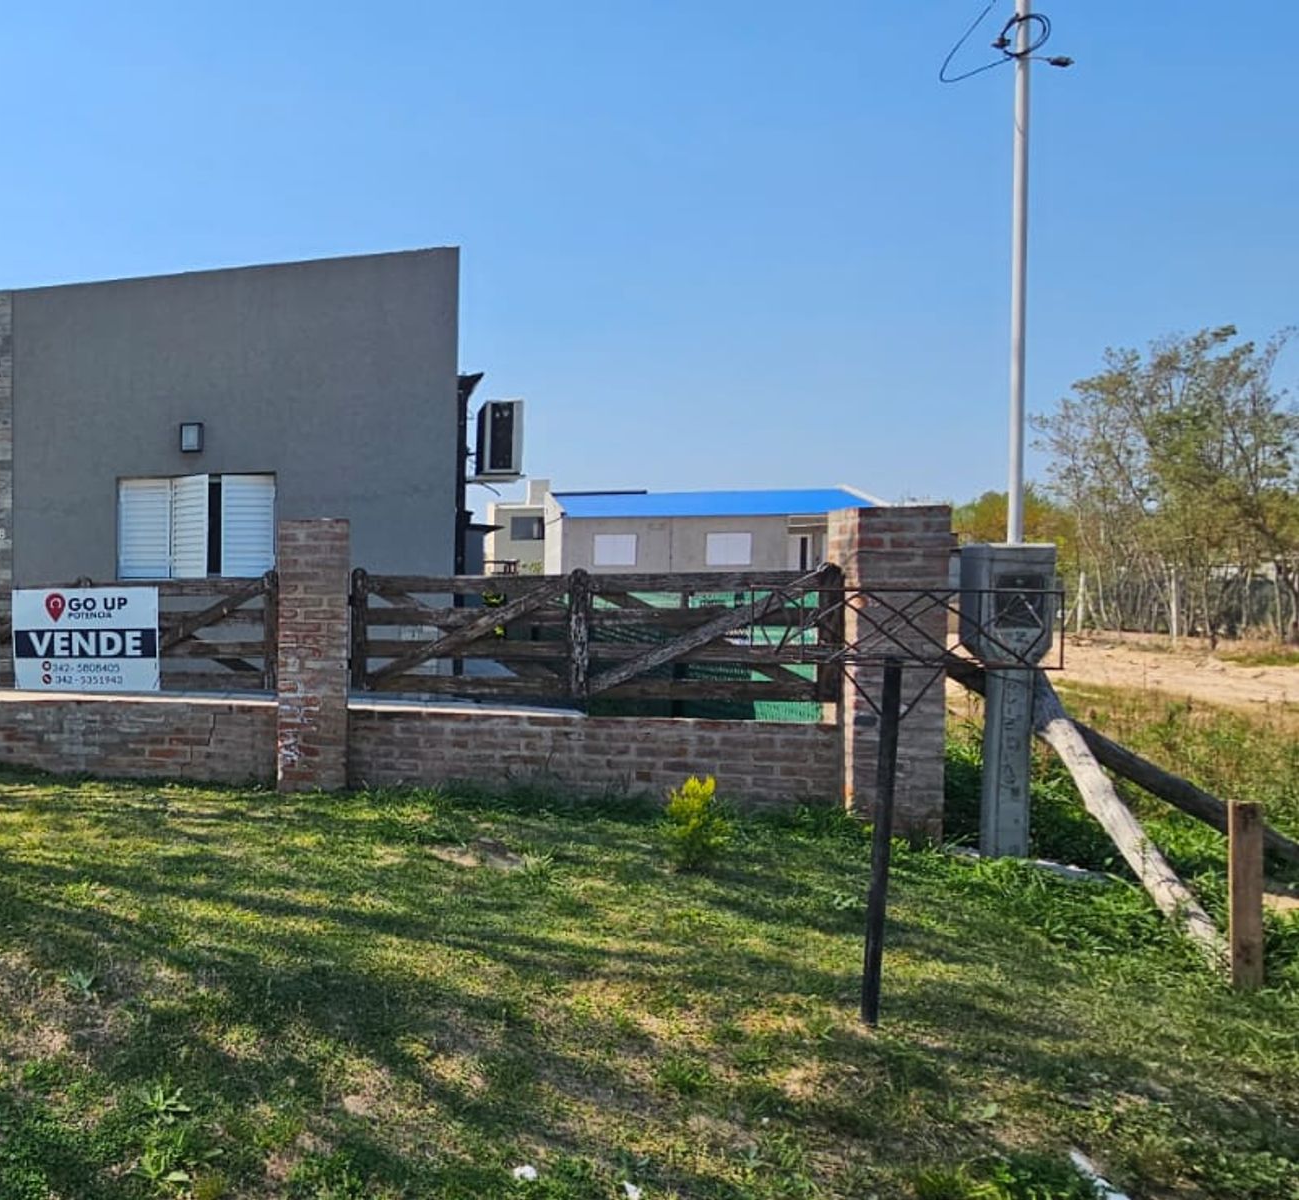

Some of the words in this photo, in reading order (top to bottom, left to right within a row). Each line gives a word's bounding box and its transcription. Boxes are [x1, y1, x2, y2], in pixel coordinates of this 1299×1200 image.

[68, 597, 96, 612] GO
[103, 597, 128, 611] UP
[29, 631, 142, 657] VENDE
